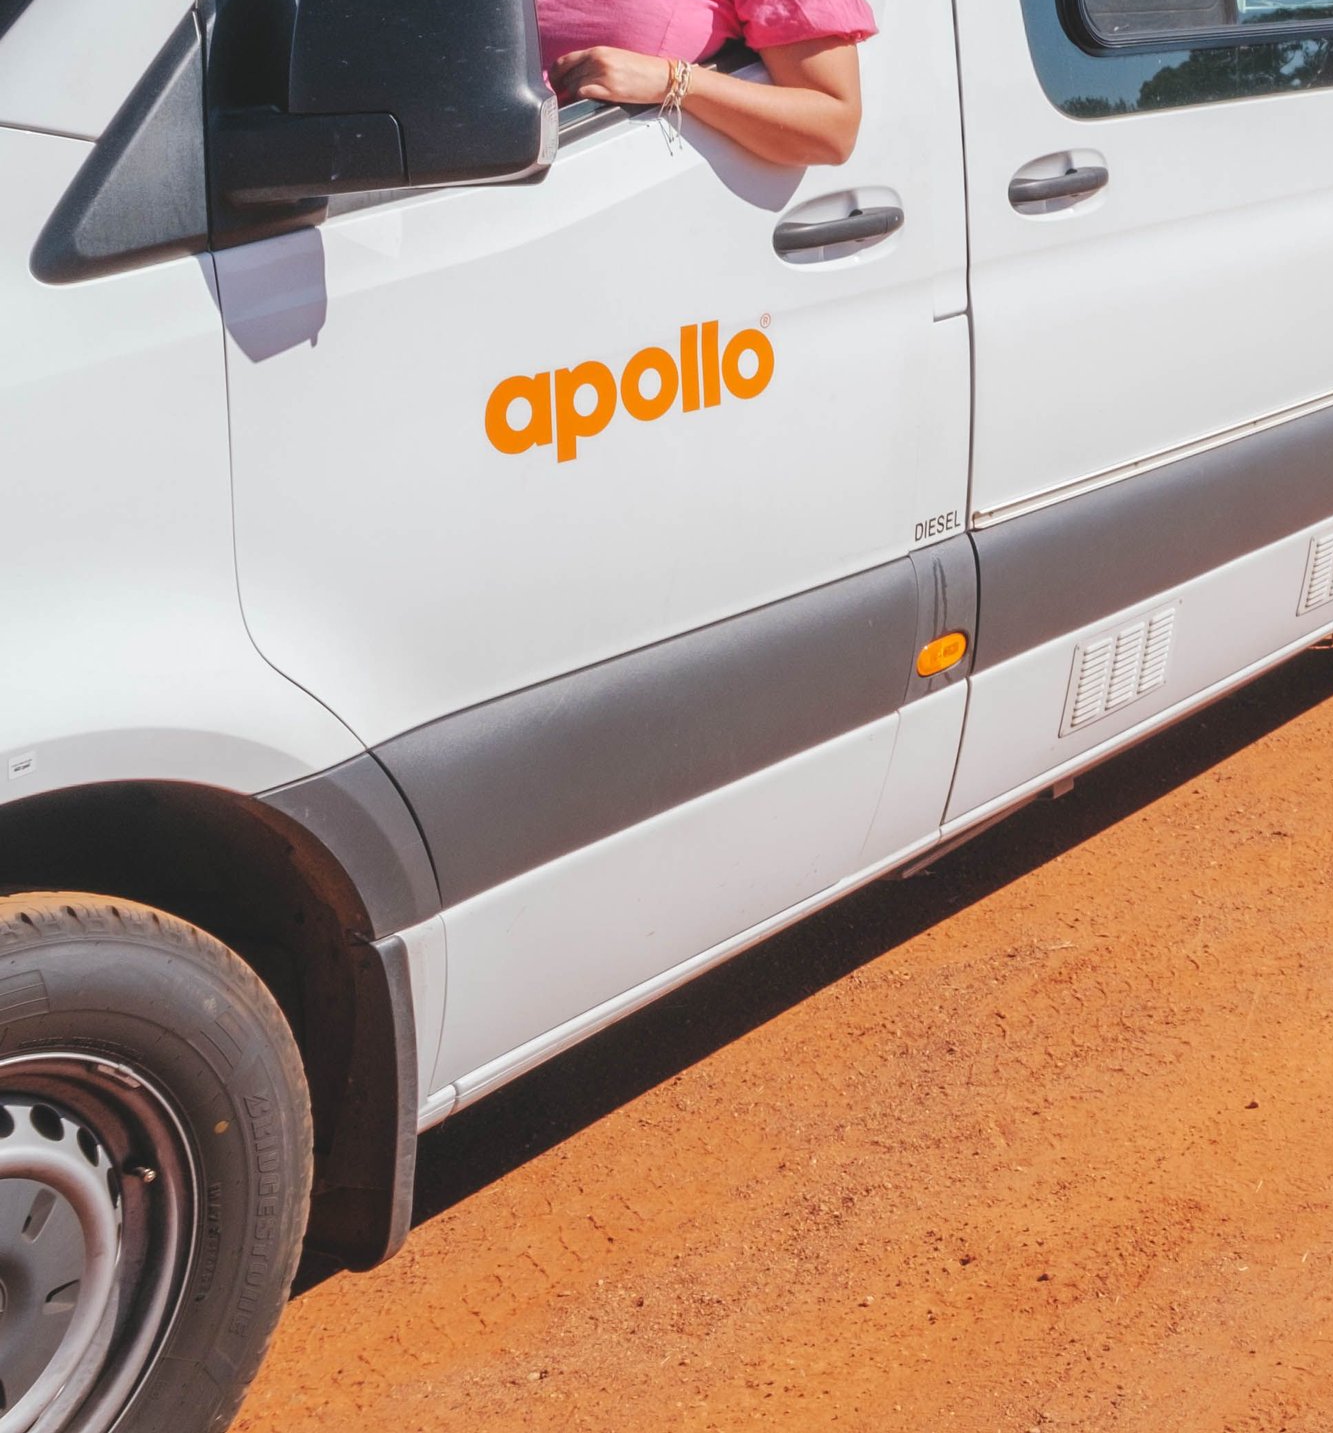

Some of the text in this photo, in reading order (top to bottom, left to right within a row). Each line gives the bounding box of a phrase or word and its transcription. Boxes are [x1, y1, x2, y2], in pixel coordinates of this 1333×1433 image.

[484, 319, 775, 464] apollo
[914, 510, 961, 542] DIESEL
[228, 1094, 281, 1338] BRIDGESTONE
